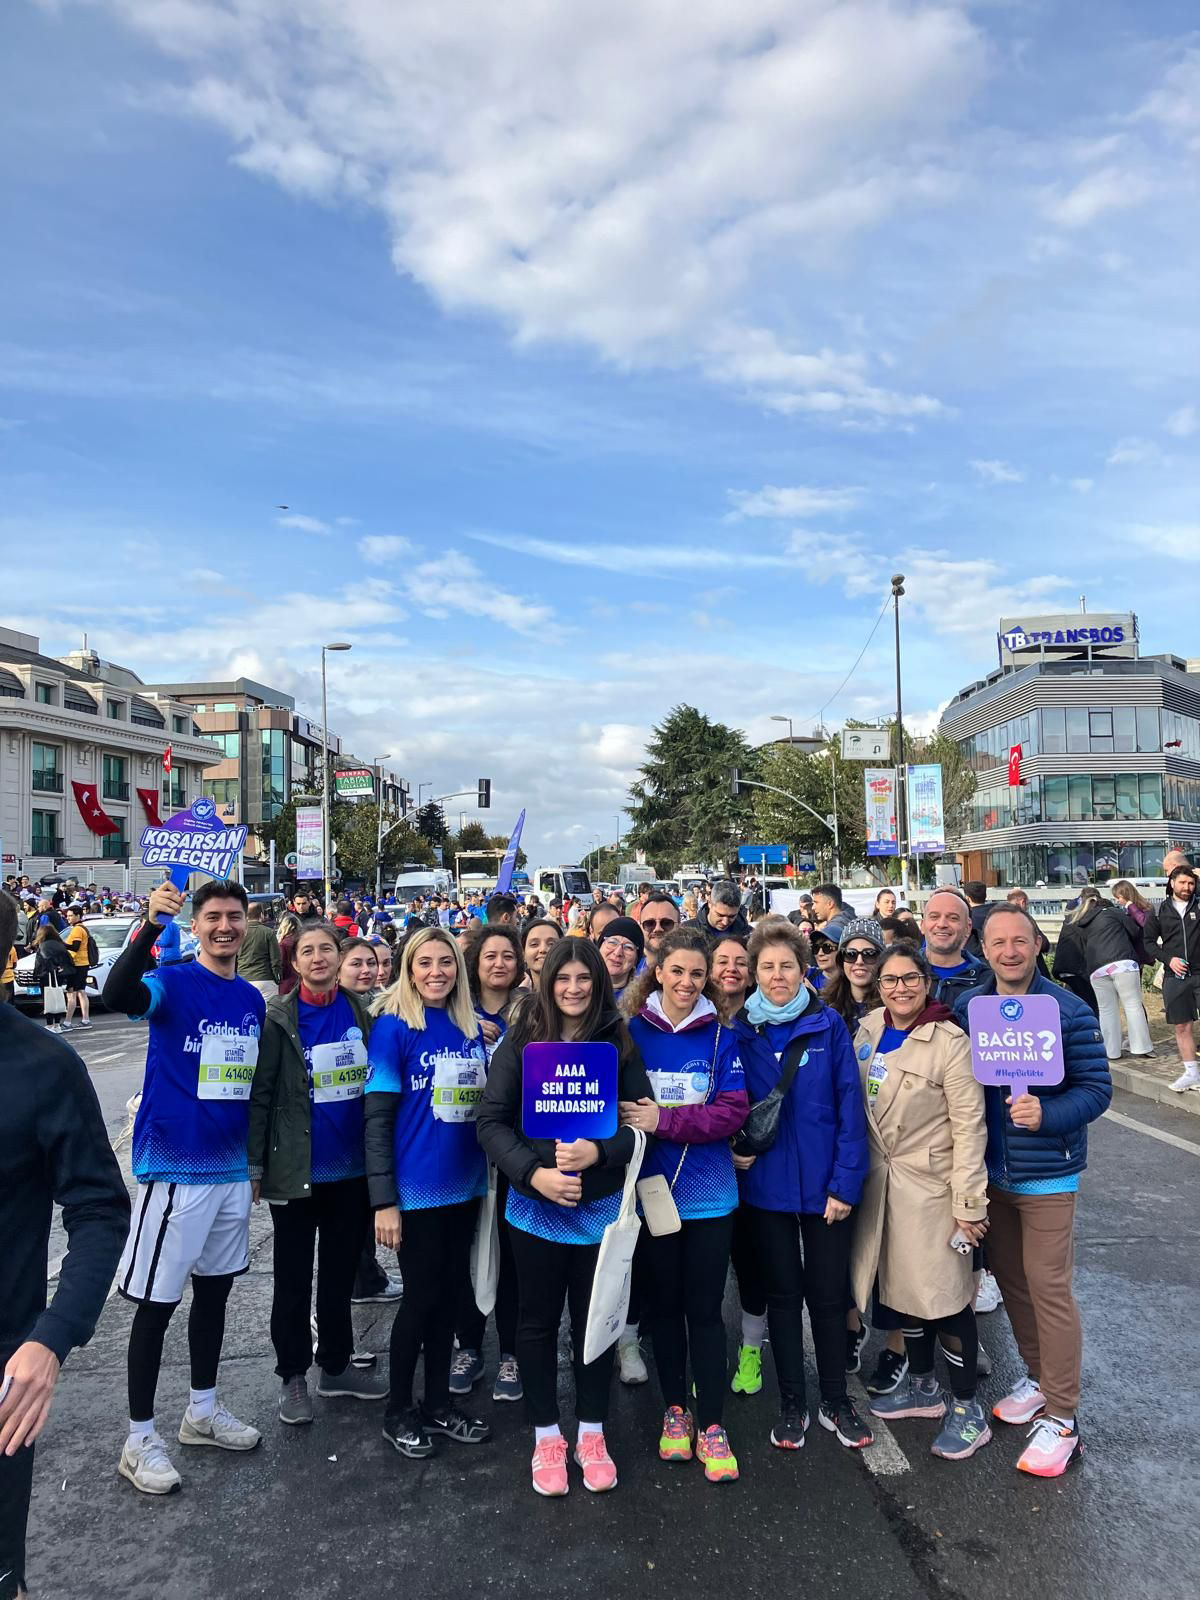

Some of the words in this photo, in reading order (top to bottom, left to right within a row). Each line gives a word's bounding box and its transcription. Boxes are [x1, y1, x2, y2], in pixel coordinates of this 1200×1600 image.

[1004, 632, 1026, 649] TB
[1030, 626, 1125, 643] TRANSBOS
[143, 828, 244, 850] KOŞARSAN
[146, 847, 232, 877] GELECEK!
[977, 1027, 1034, 1052] BAĞIŞ
[978, 1051, 1020, 1061] YAPTIN
[1023, 1052, 1038, 1061] MI
[225, 1067, 253, 1081] 41408
[338, 1067, 368, 1083] 41395
[555, 1064, 586, 1077] AAAA
[411, 1074, 429, 1091] bir
[542, 1082, 564, 1095] SEN
[567, 1082, 582, 1095] DE
[585, 1079, 599, 1095] Mİ
[535, 1100, 606, 1113] BURADASIN?
